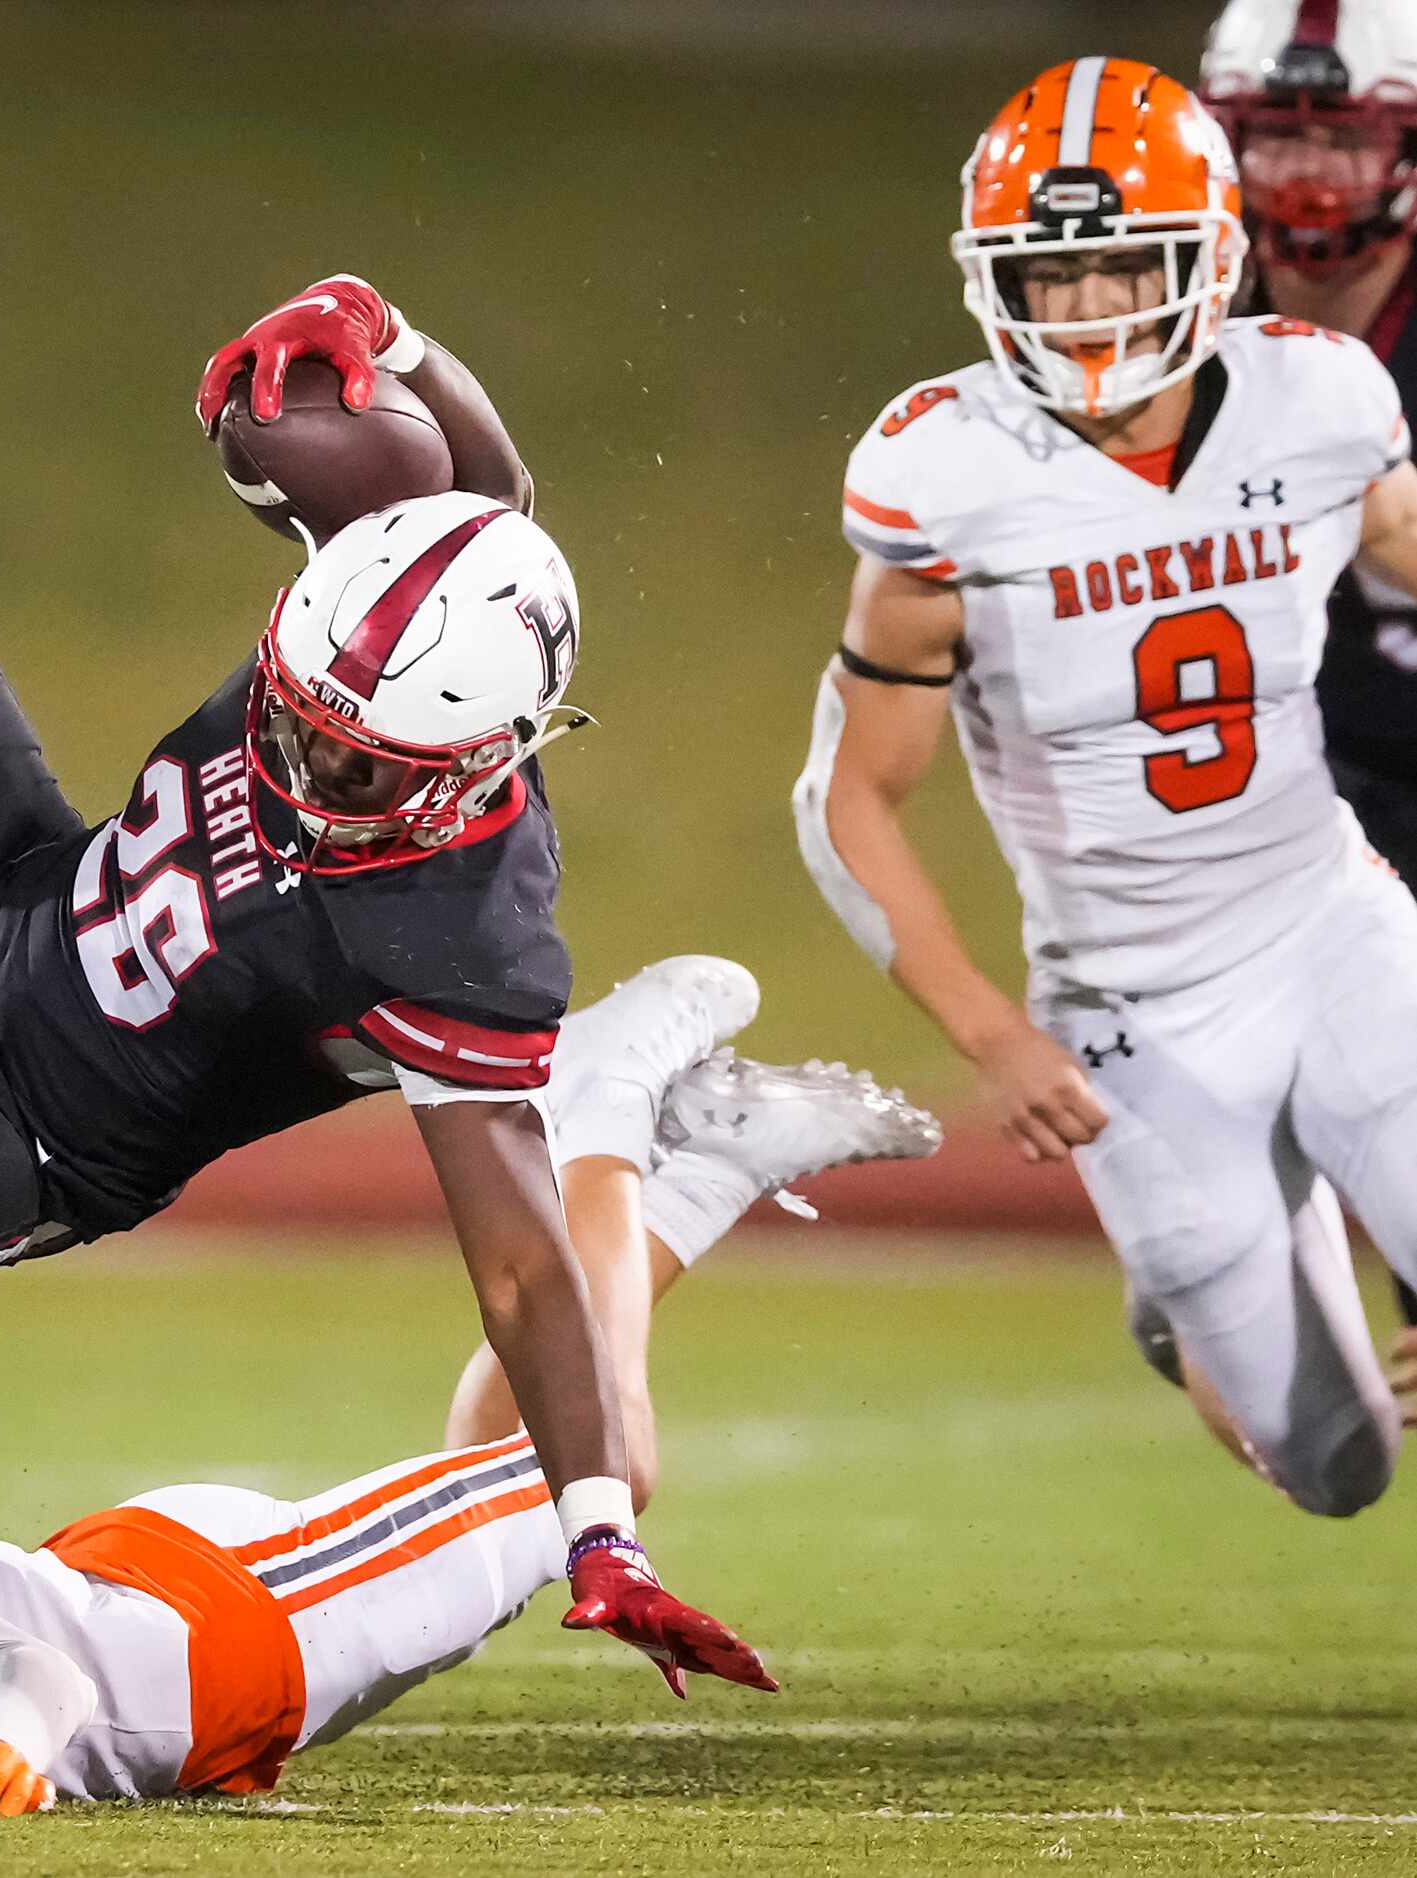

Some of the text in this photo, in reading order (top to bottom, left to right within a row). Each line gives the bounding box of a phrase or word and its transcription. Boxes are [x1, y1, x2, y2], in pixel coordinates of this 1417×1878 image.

[880, 386, 959, 438] 9
[1048, 524, 1301, 620] ROCKWALL
[1132, 603, 1258, 815] 9
[72, 754, 218, 1033] 26
[196, 744, 263, 902] HEATH
